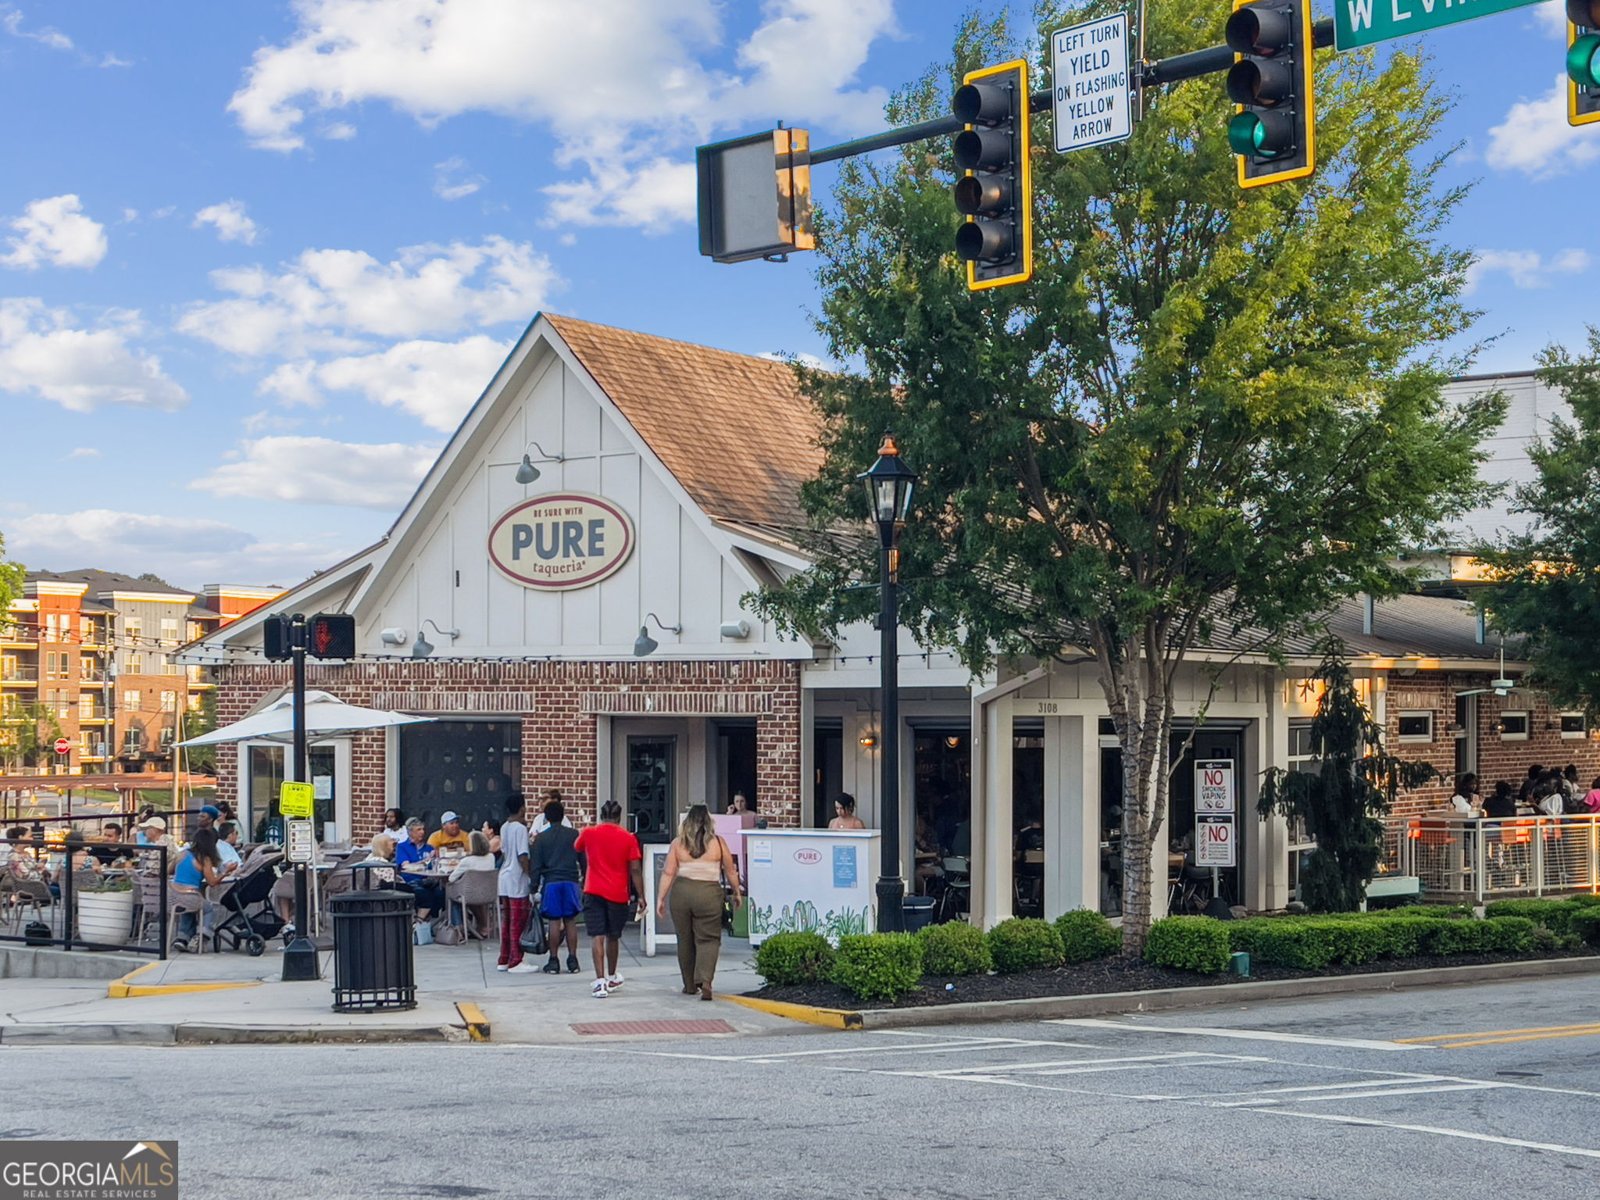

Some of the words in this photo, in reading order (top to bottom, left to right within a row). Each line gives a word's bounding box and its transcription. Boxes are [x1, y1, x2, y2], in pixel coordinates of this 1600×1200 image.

[1059, 32, 1085, 54] LEFT
[1091, 23, 1120, 45] TURN
[1070, 49, 1110, 76] YIELD
[1057, 85, 1071, 102] ON
[1076, 71, 1125, 98] FLASHING
[1069, 95, 1114, 120] YELLOW
[1073, 117, 1112, 140] ARROW
[533, 509, 542, 518] BE
[544, 507, 562, 517] SURE
[564, 506, 583, 516] WITH
[512, 519, 605, 561] PURE
[1038, 702, 1058, 714] 3108
[1204, 770, 1224, 786] NO
[1202, 793, 1227, 801] VAPING
[1208, 825, 1229, 842] NO
[797, 852, 818, 861] PURE
